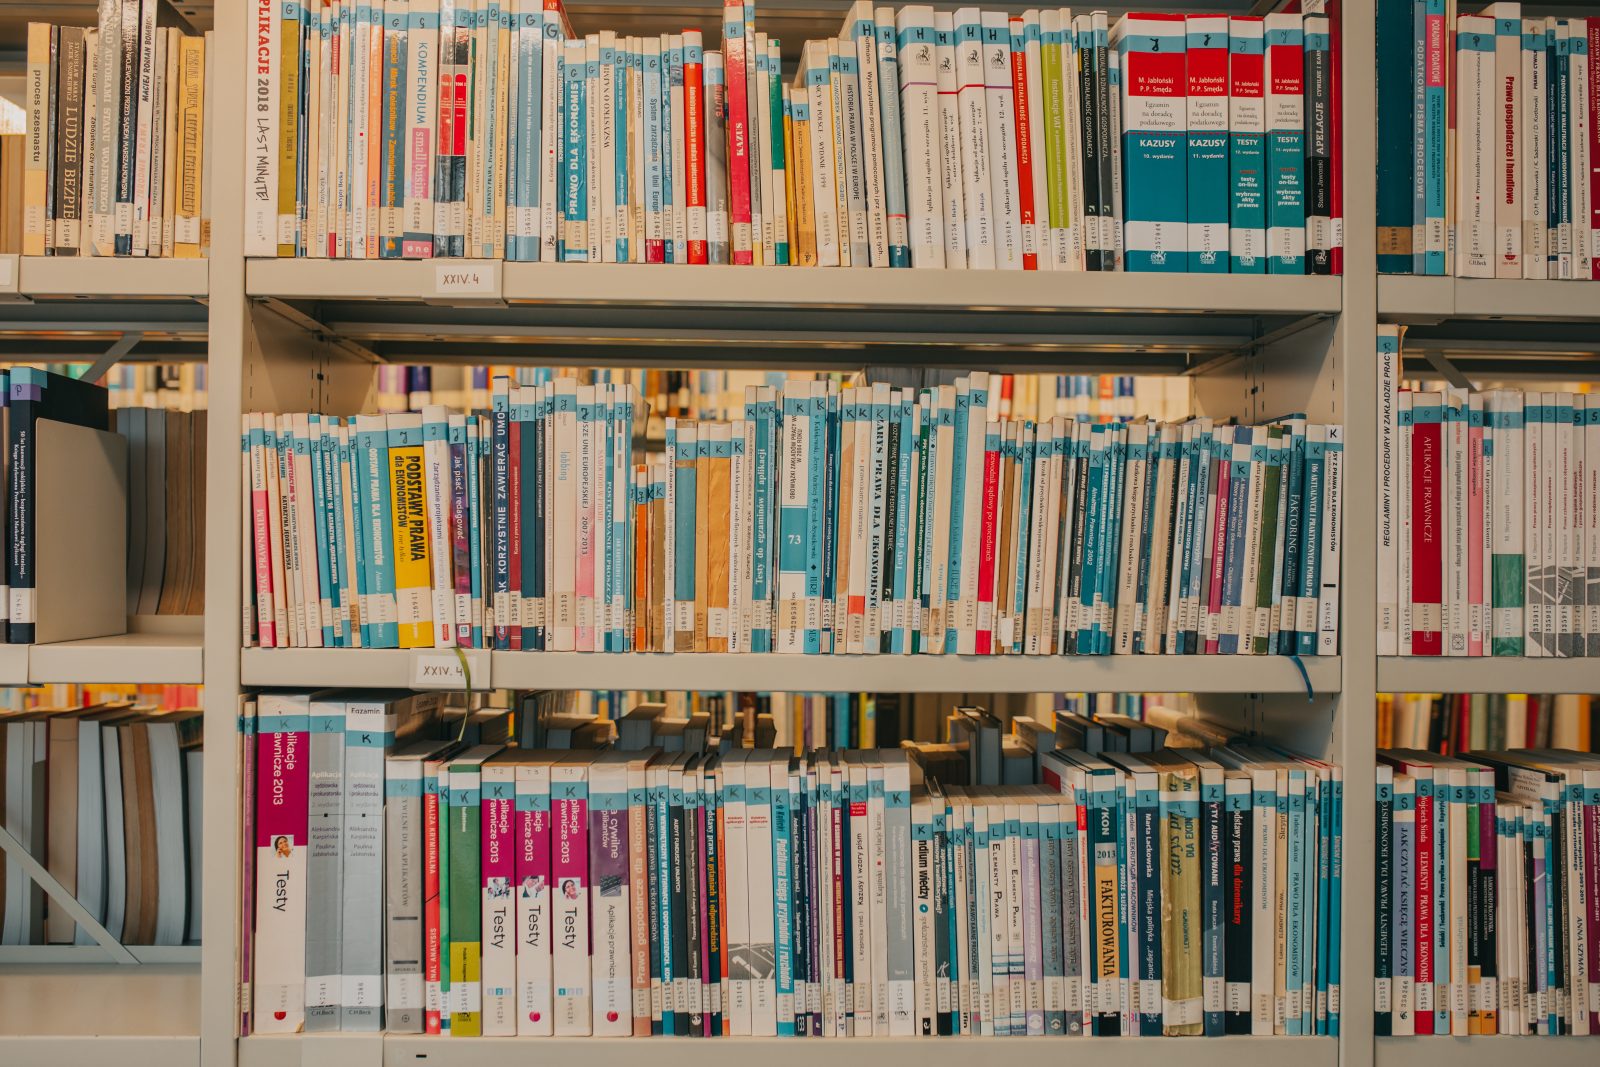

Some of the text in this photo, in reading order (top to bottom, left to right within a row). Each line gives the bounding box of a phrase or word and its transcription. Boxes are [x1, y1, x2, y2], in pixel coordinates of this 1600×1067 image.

[141, 47, 152, 102] MACIEJ ROMAN
[415, 42, 429, 125] KOMPENDIUM
[1147, 76, 1174, 84] Jabłoński
[1198, 76, 1225, 84] Jabłoński
[1504, 76, 1515, 103] Prawo
[257, 78, 269, 112] 2018
[649, 98, 658, 122] System
[846, 84, 856, 112] HISTORIA
[32, 69, 43, 162] proces szesnastu
[102, 107, 111, 142] STANU
[847, 112, 857, 135] PRAWA
[1315, 102, 1324, 156] APELACJE
[1415, 39, 1425, 200] PODATKOWE PISMA PROCESOWE
[1503, 103, 1515, 158] gospodarcze
[65, 106, 78, 163] LUDZIE
[255, 118, 270, 150] LAST
[414, 131, 427, 160] small
[649, 124, 659, 163] zarządzania
[734, 122, 744, 157] KAZUS
[1018, 122, 1028, 164] GOSPODARCZA
[1084, 116, 1093, 158] GOSPODARCZA
[1139, 139, 1176, 148] KAZUSY
[1189, 139, 1226, 148] KAZUSY
[1277, 136, 1299, 144] TESTY
[568, 148, 579, 170] DLA
[849, 142, 859, 165] POLSCE
[99, 146, 110, 212] WOJENNEGO
[568, 174, 579, 215] PRAWO
[851, 175, 860, 201] EUROPIE
[1505, 162, 1515, 205] handlowe
[1382, 379, 1392, 425] ZAKŁADZIE
[1382, 425, 1391, 435] W
[453, 455, 463, 470] Jak
[495, 442, 507, 499] ZAWIERAĆ
[557, 451, 570, 482] lobbing
[756, 448, 767, 485] aplikacji
[1382, 435, 1392, 488] PROCEDURY
[394, 455, 408, 528] dla EKONOMISTÓW
[453, 470, 463, 491] pisać
[581, 456, 589, 509] EUROPEJSKIEJ
[872, 459, 884, 529] PRAWA DLA
[1422, 436, 1433, 543] APLIKACJE PRAWNICZE
[281, 495, 289, 528] KATARZYNA
[405, 455, 426, 561] PODSTAWY PRAWA
[453, 496, 465, 540] redagować
[755, 497, 766, 544] egzaminów
[1217, 497, 1227, 532] OCHRONA
[1287, 493, 1300, 554] FAKTORING
[1382, 493, 1392, 547] REGULAMINY
[256, 508, 267, 569] PRAWNIKIEM
[497, 506, 507, 574] KORZYSTNIE
[755, 547, 764, 559] do
[984, 521, 994, 562] procedurach
[755, 563, 766, 585] Testy
[1086, 549, 1094, 566] 2002
[272, 778, 285, 806] 2013
[427, 795, 437, 875] ANALIZA KRYMINALNA
[610, 817, 619, 859] cywilne
[1144, 813, 1152, 835] Marta
[1419, 823, 1428, 843] Siuda
[489, 841, 499, 864] 2013
[524, 839, 534, 863] 2013
[560, 841, 570, 864] 2013
[1096, 849, 1117, 860] 2013
[1232, 840, 1242, 863] prawa
[917, 869, 930, 900] wiedzy
[1233, 864, 1243, 877] dla
[1292, 872, 1300, 899] PRAWO
[1398, 827, 1411, 927] JAK CZYTAĆ KSIĘGĘ
[1419, 851, 1430, 891] ELEMENTY
[272, 869, 290, 913] Testy
[857, 880, 865, 906] Kazusy
[1379, 859, 1388, 956] ELEMENTY PRAWA DLA
[1419, 894, 1429, 920] PRAWA
[525, 904, 541, 948] Testy
[633, 856, 648, 984] Prawo gospodarcze dla
[1145, 889, 1155, 942] Miejska polityka
[1292, 901, 1300, 918] DLA
[429, 927, 438, 962] ANALYSIS
[490, 906, 507, 950] Testy
[561, 906, 578, 950] Testy
[1100, 879, 1115, 977] FAKTUROWANIA
[1419, 923, 1429, 939] DLA
[1576, 916, 1584, 941] ANNA
